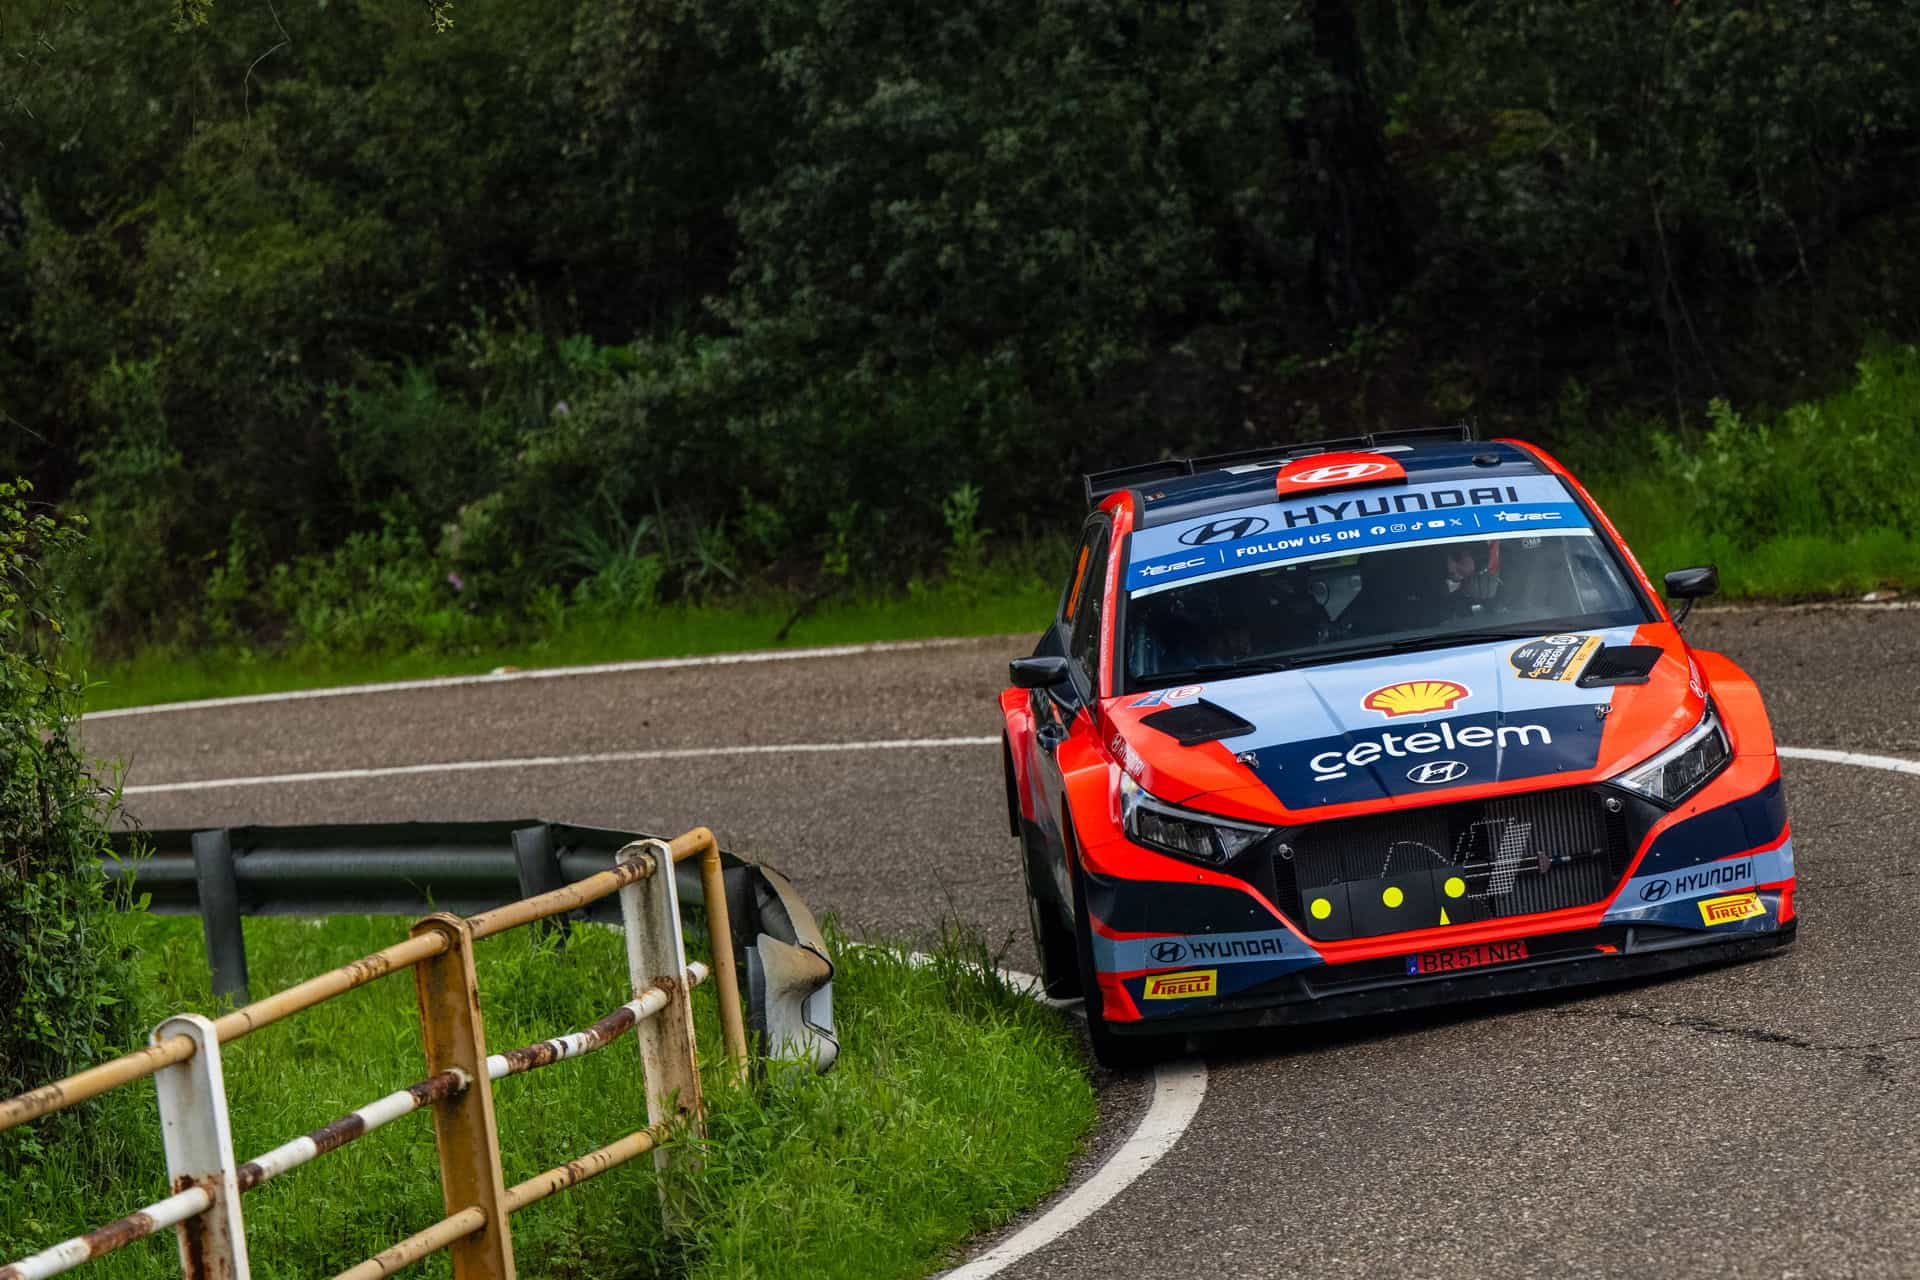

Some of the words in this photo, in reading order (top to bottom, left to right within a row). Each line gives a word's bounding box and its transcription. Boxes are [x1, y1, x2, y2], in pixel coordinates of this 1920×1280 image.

[1283, 486, 1519, 528] HYUNDAI
[1236, 538, 1304, 557] FOLLOW
[1309, 533, 1332, 544] US
[1336, 529, 1360, 540] ON
[1310, 722, 1552, 782] cetelem
[1675, 862, 1752, 895] HYUNDAI
[1705, 898, 1758, 921] PIRELLI
[1190, 938, 1284, 959] HYUNDAI
[1152, 975, 1211, 995] PIRELLI
